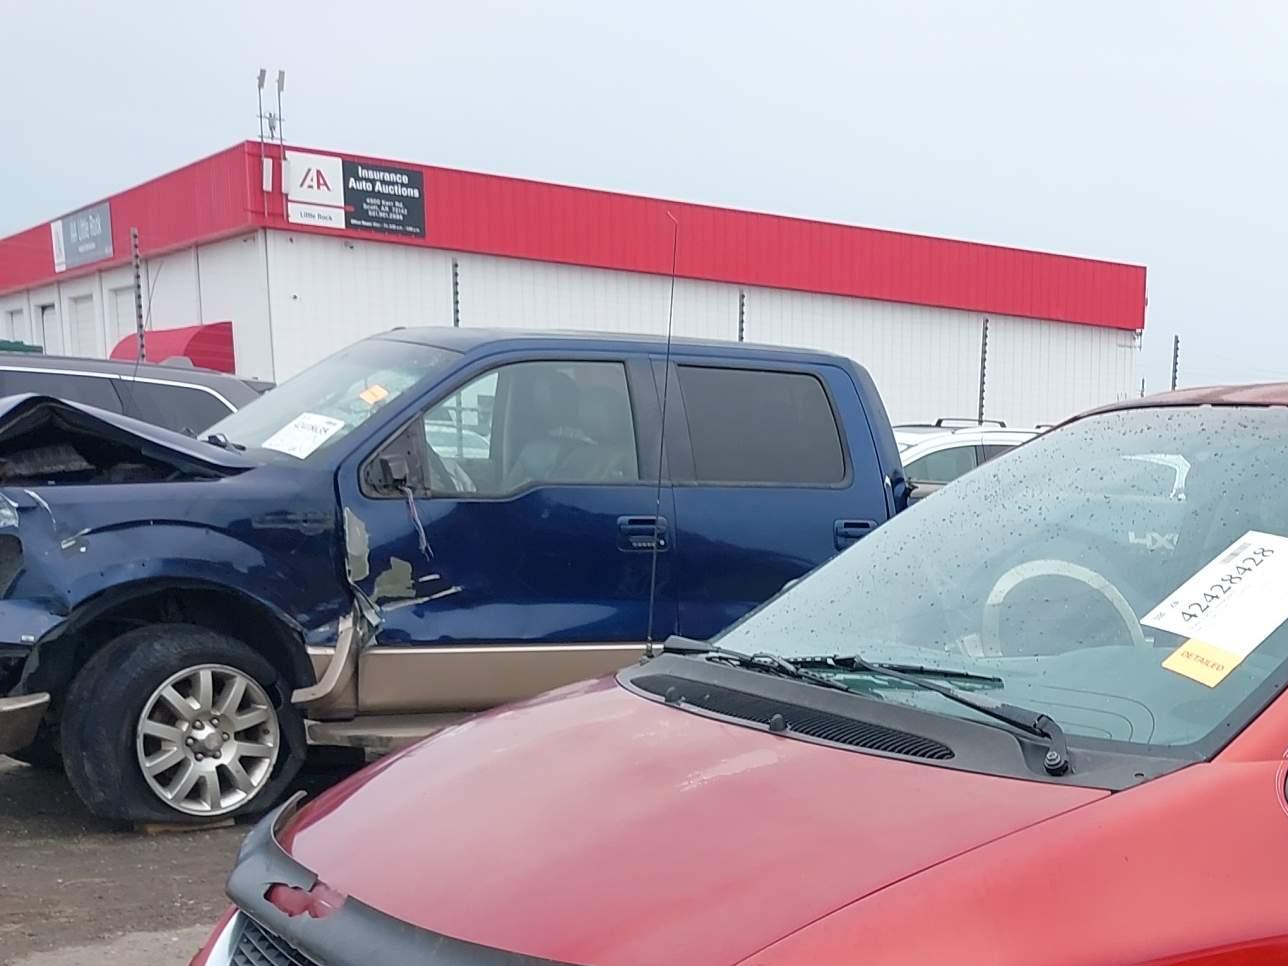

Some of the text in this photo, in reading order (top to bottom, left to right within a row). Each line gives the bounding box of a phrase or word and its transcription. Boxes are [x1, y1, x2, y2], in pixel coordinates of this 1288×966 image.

[358, 165, 409, 184] Insurance
[348, 177, 420, 198] Auto Auctions
[1181, 547, 1275, 622] 42428428
[1181, 650, 1225, 672] DETAILED
